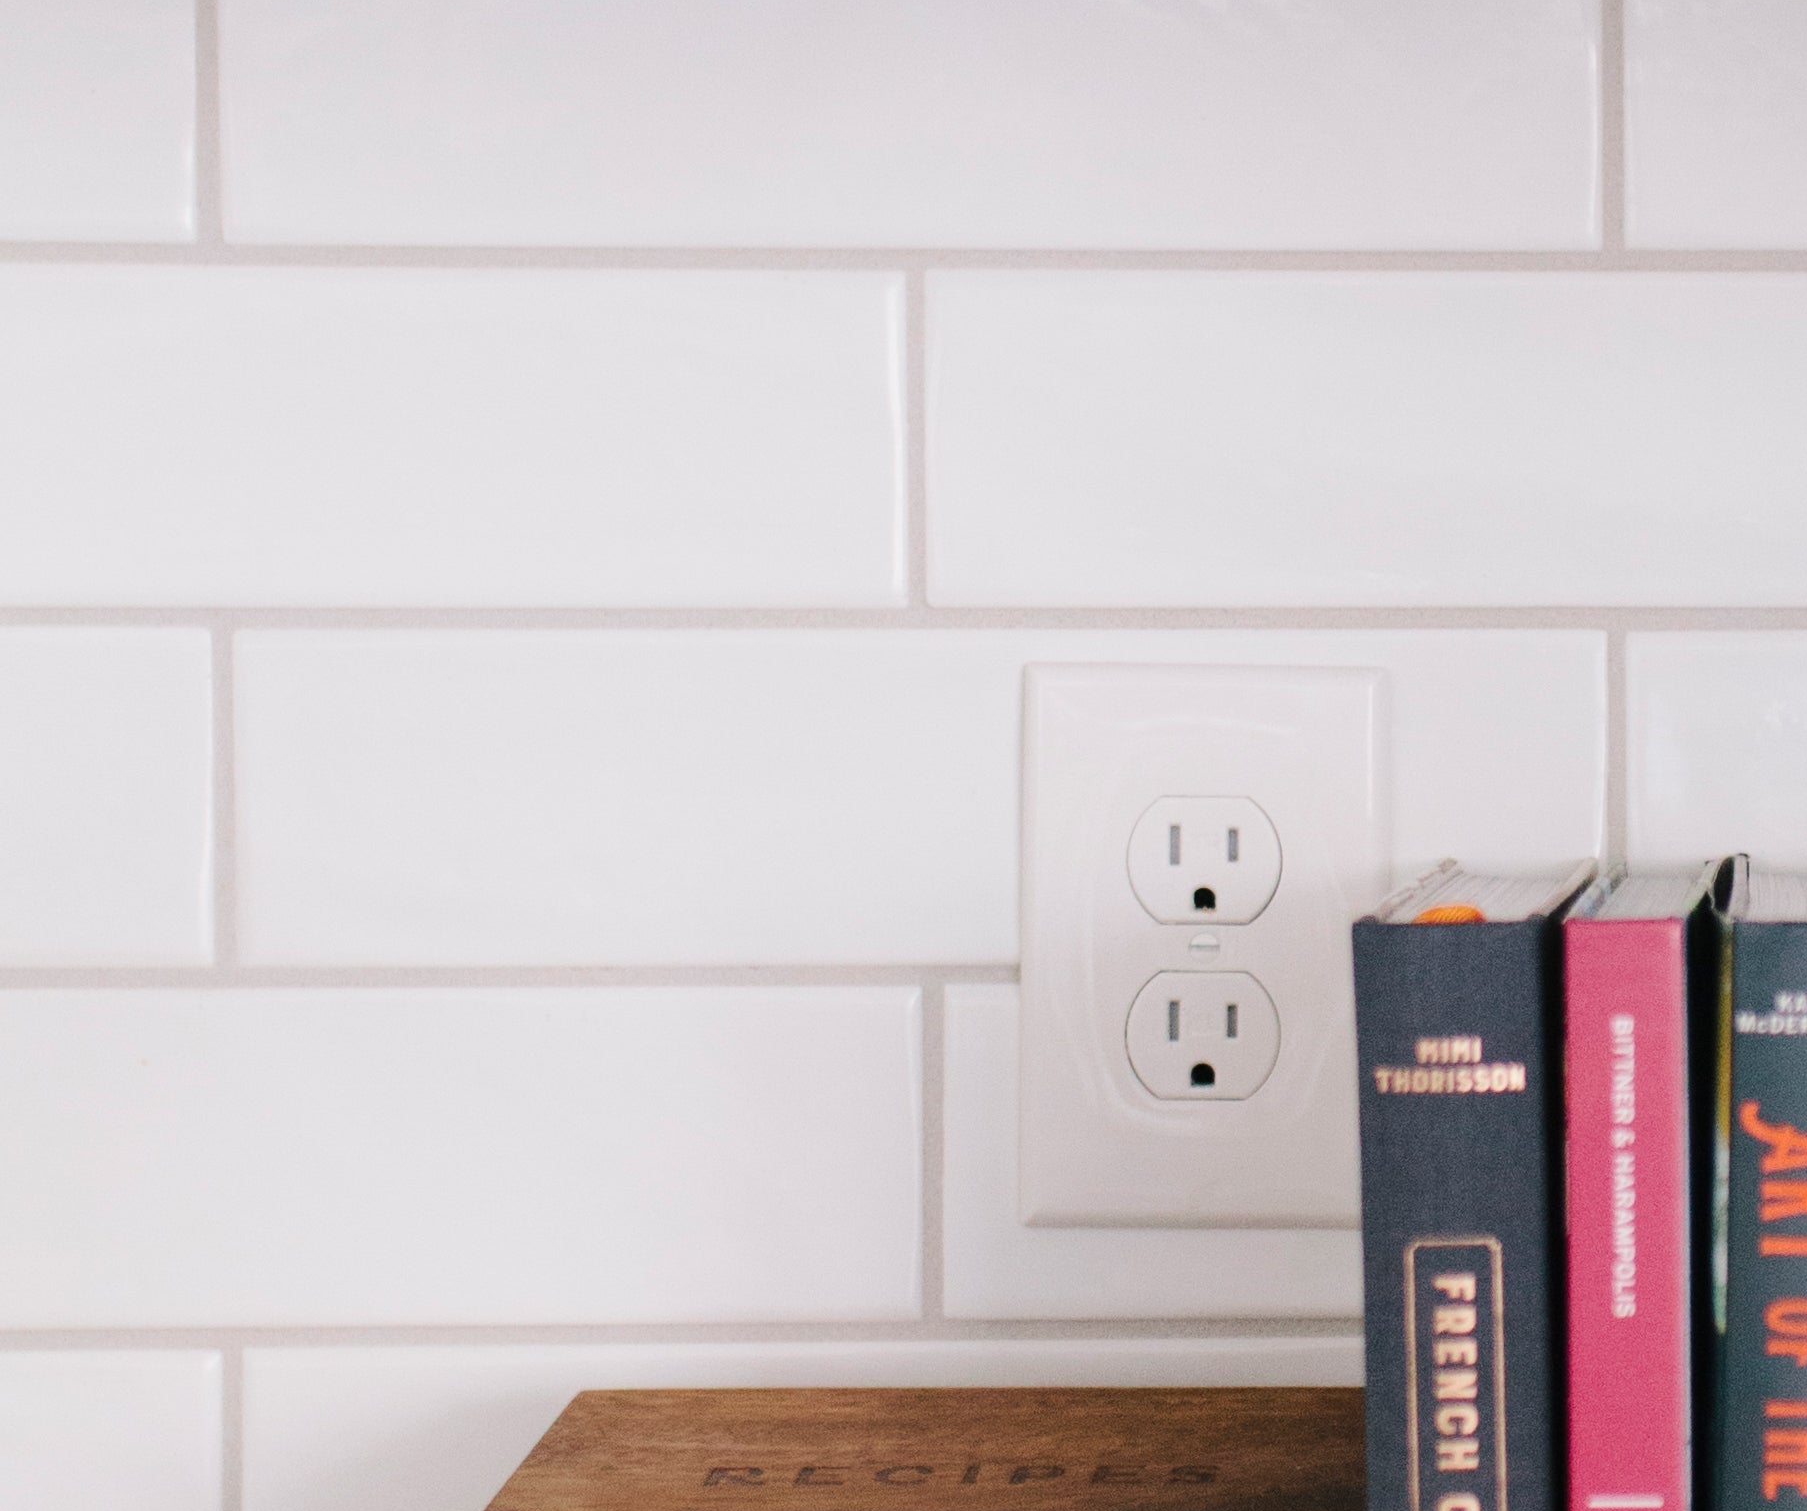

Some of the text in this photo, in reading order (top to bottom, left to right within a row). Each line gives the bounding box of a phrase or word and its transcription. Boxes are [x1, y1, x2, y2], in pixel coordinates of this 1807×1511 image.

[1415, 1036, 1482, 1064] MIMI
[1374, 1063, 1526, 1093] THORISSON
[1610, 1013, 1637, 1318] BITTNER & HARAMPOLIS
[1431, 1272, 1480, 1472] FRENCH
[702, 1463, 1224, 1488] RECIPES
